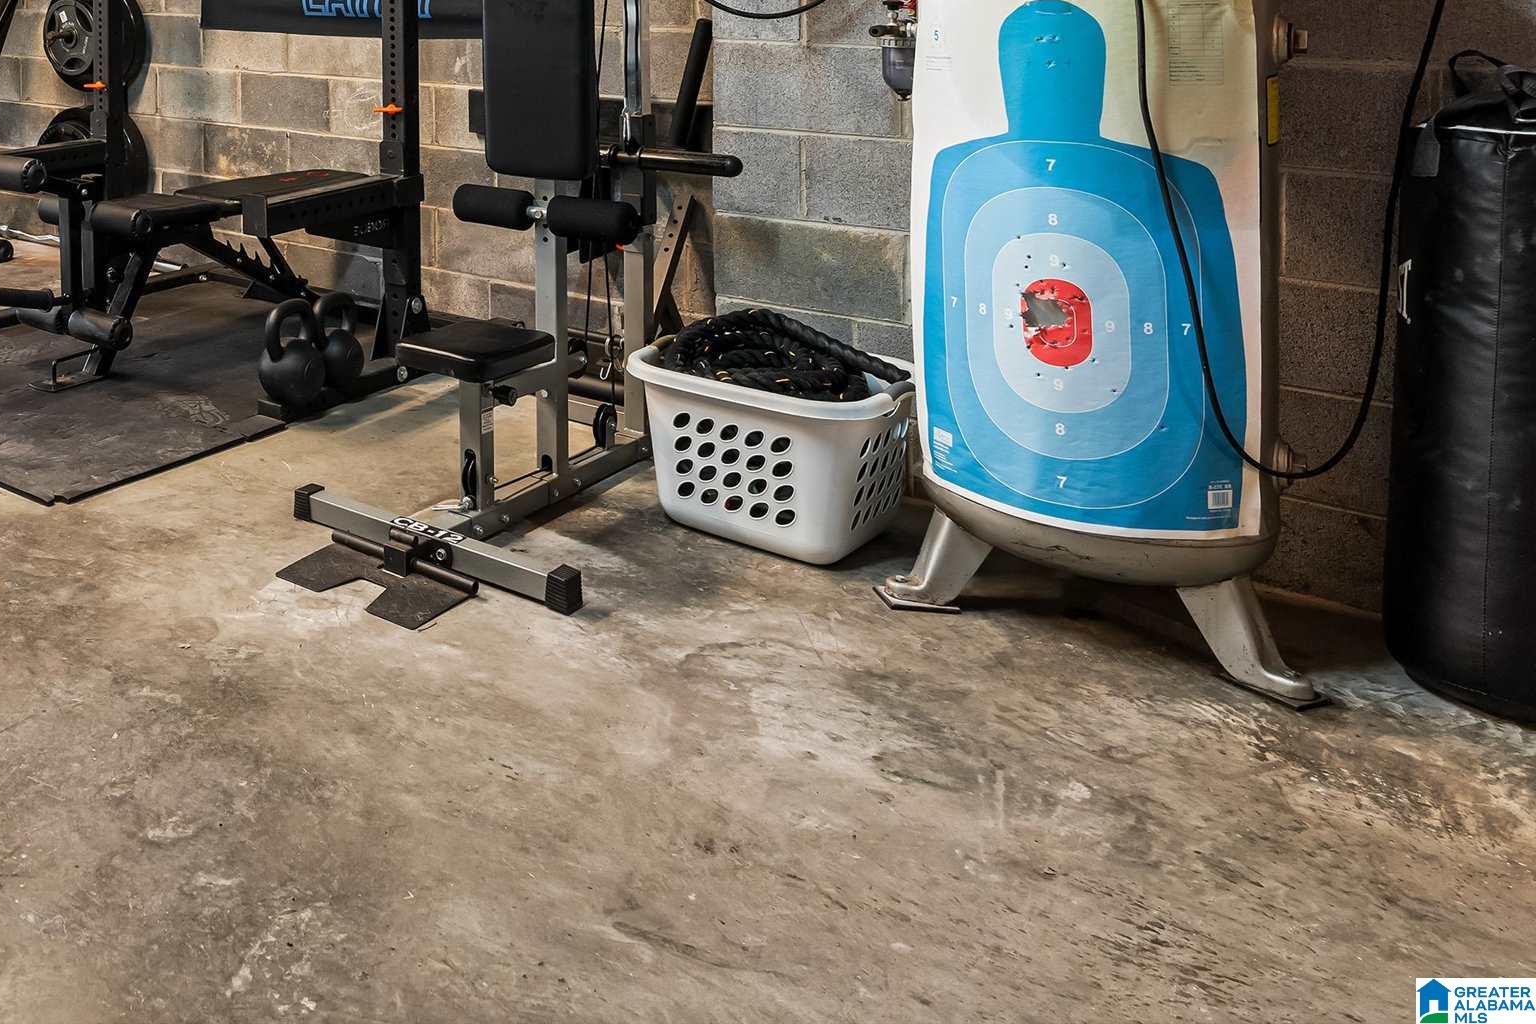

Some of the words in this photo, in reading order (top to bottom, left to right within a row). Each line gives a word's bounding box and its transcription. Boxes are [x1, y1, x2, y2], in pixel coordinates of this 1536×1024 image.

[1046, 159, 1057, 172] 7
[1048, 213, 1058, 226] 8
[1049, 254, 1060, 268] 9
[950, 296, 958, 308] 7
[978, 303, 987, 315] 8
[1105, 320, 1115, 334] 9
[1143, 322, 1154, 335] 8
[1181, 323, 1191, 336] 7
[1054, 378, 1064, 392] 9
[1055, 423, 1065, 436] 8
[1056, 476, 1067, 489] 7
[393, 517, 464, 544] CB-12
